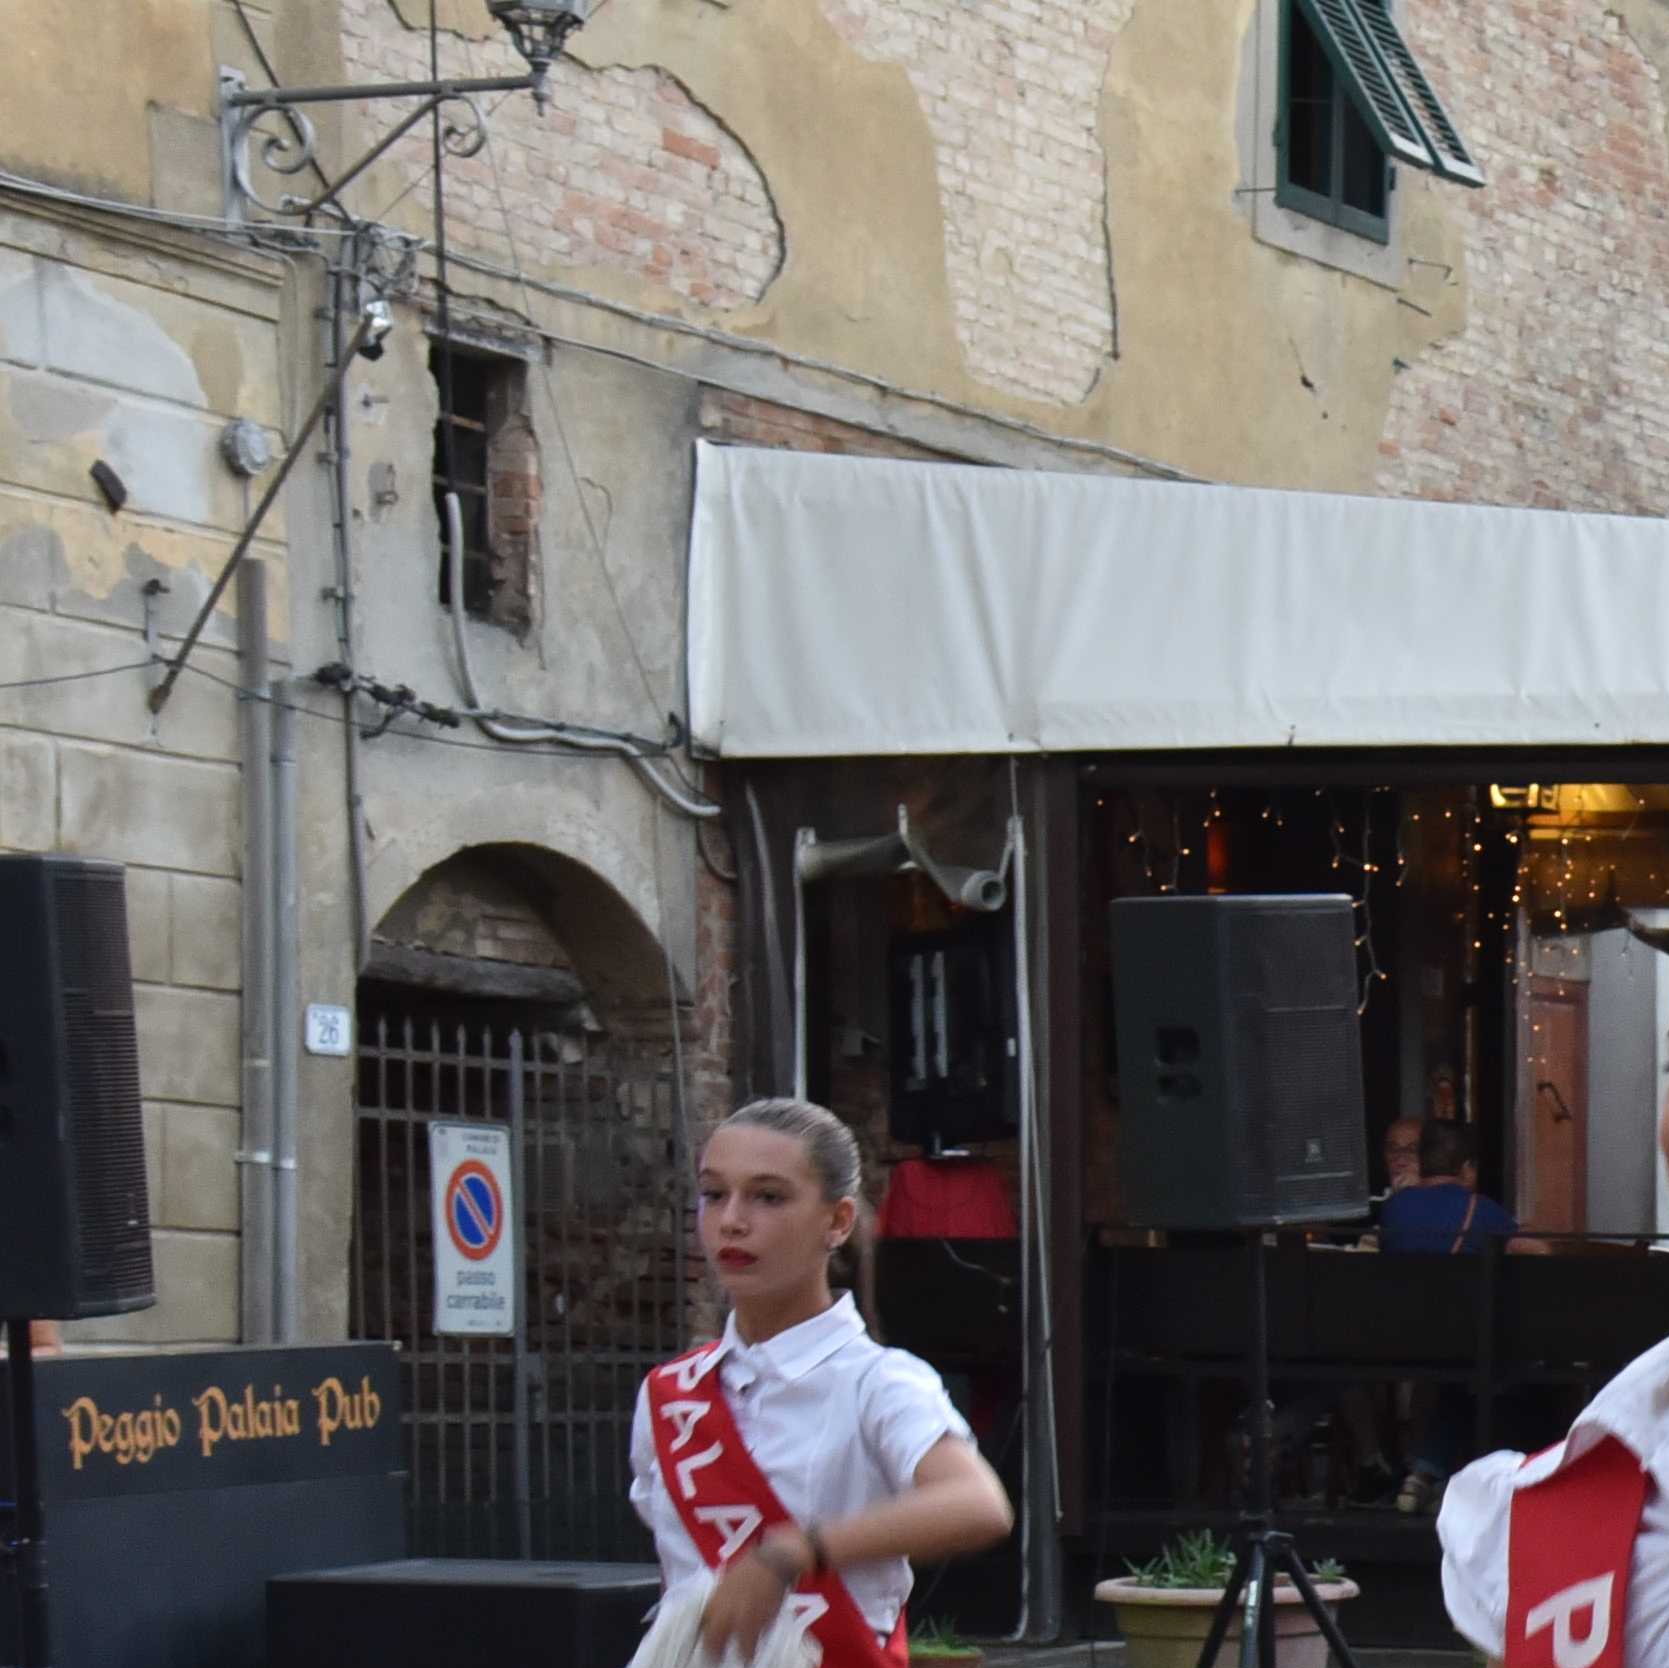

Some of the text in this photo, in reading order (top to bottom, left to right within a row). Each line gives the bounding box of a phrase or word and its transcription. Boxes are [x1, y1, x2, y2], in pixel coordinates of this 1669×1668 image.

[456, 1270, 496, 1287] passo
[62, 1376, 381, 1470] Peggio Palaia Pub
